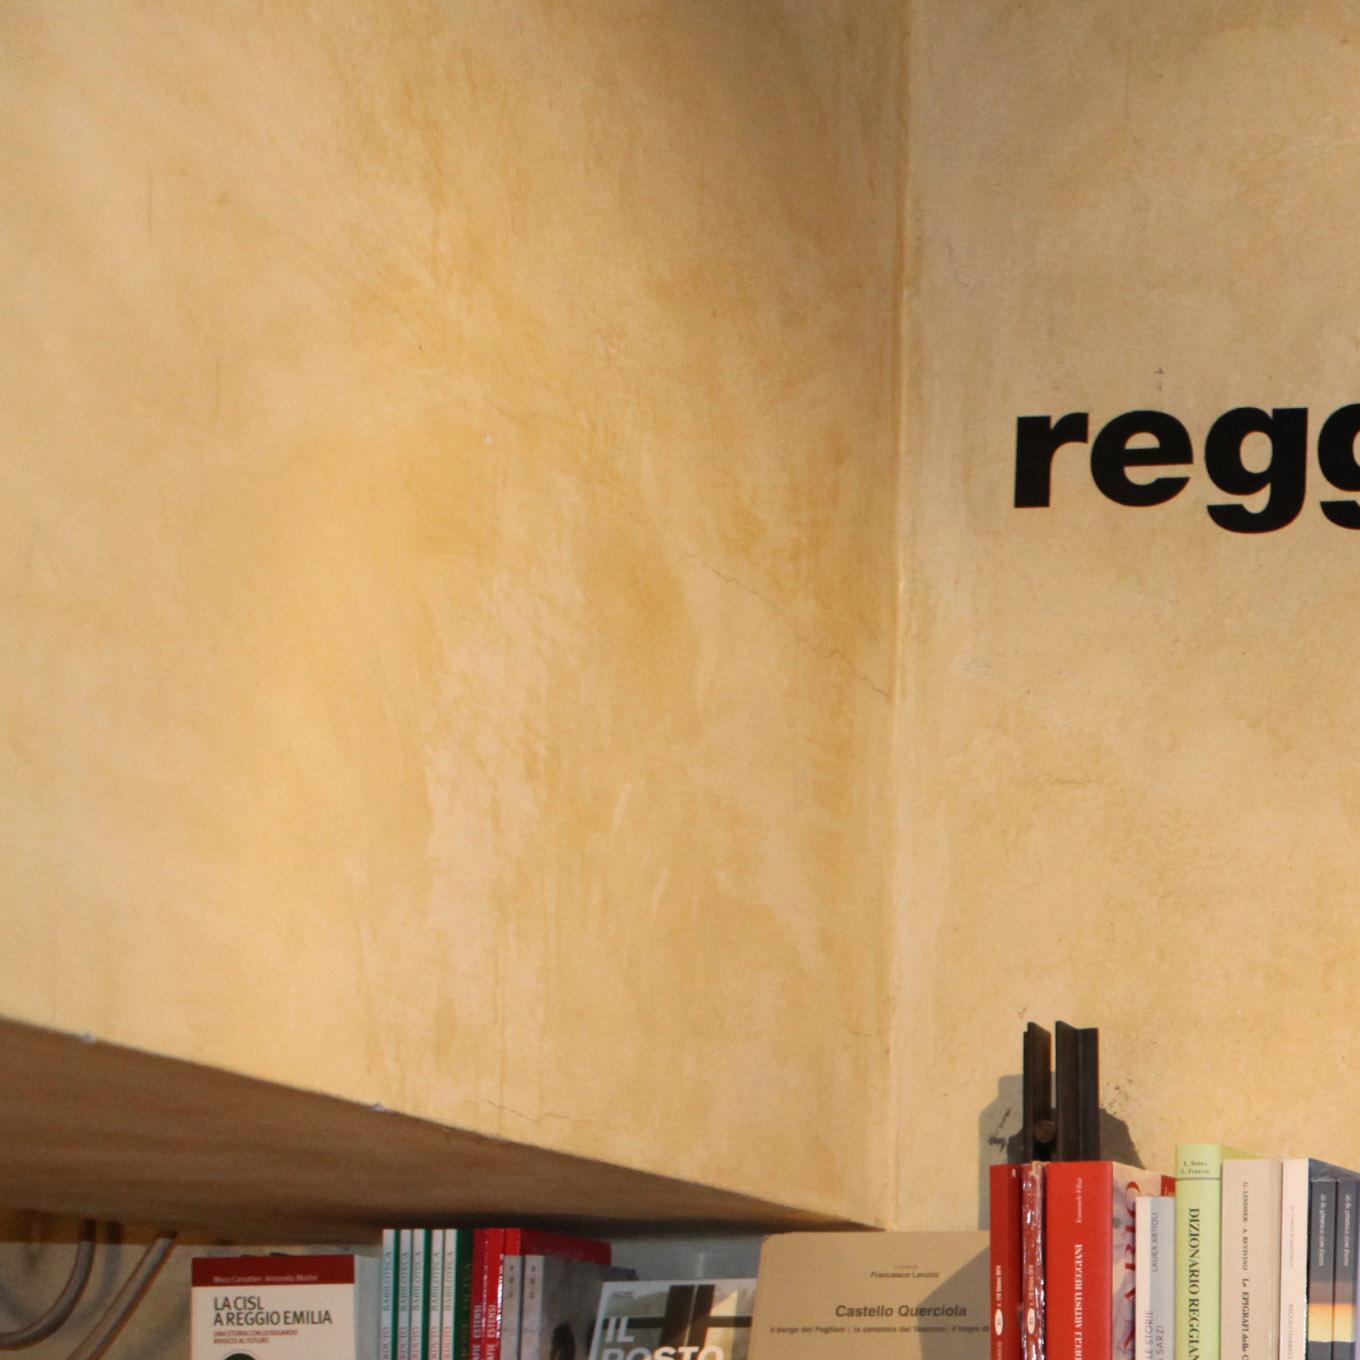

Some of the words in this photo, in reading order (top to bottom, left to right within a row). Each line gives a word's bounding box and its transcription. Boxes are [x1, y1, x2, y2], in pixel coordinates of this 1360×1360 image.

[1151, 1245, 1159, 1272] LAURA
[1188, 1208, 1200, 1295] DIZIONARIO
[1074, 1244, 1083, 1290] REGGIANI
[214, 1297, 231, 1310] LA
[233, 1297, 264, 1310] CISL
[835, 1305, 893, 1318] Castello
[898, 1304, 967, 1320] Querciola
[1074, 1290, 1083, 1329] ARTISTI
[1242, 1292, 1250, 1332] EPIGRAFI
[214, 1312, 223, 1326] A
[226, 1311, 281, 1325] REGGIO
[284, 1311, 332, 1324] EMILIA
[605, 1317, 634, 1343] IL
[1145, 1311, 1153, 1346] STORIE
[1074, 1331, 1083, 1360] DEGLI
[1156, 1325, 1164, 1355] SARZI
[1242, 1333, 1250, 1352] delle
